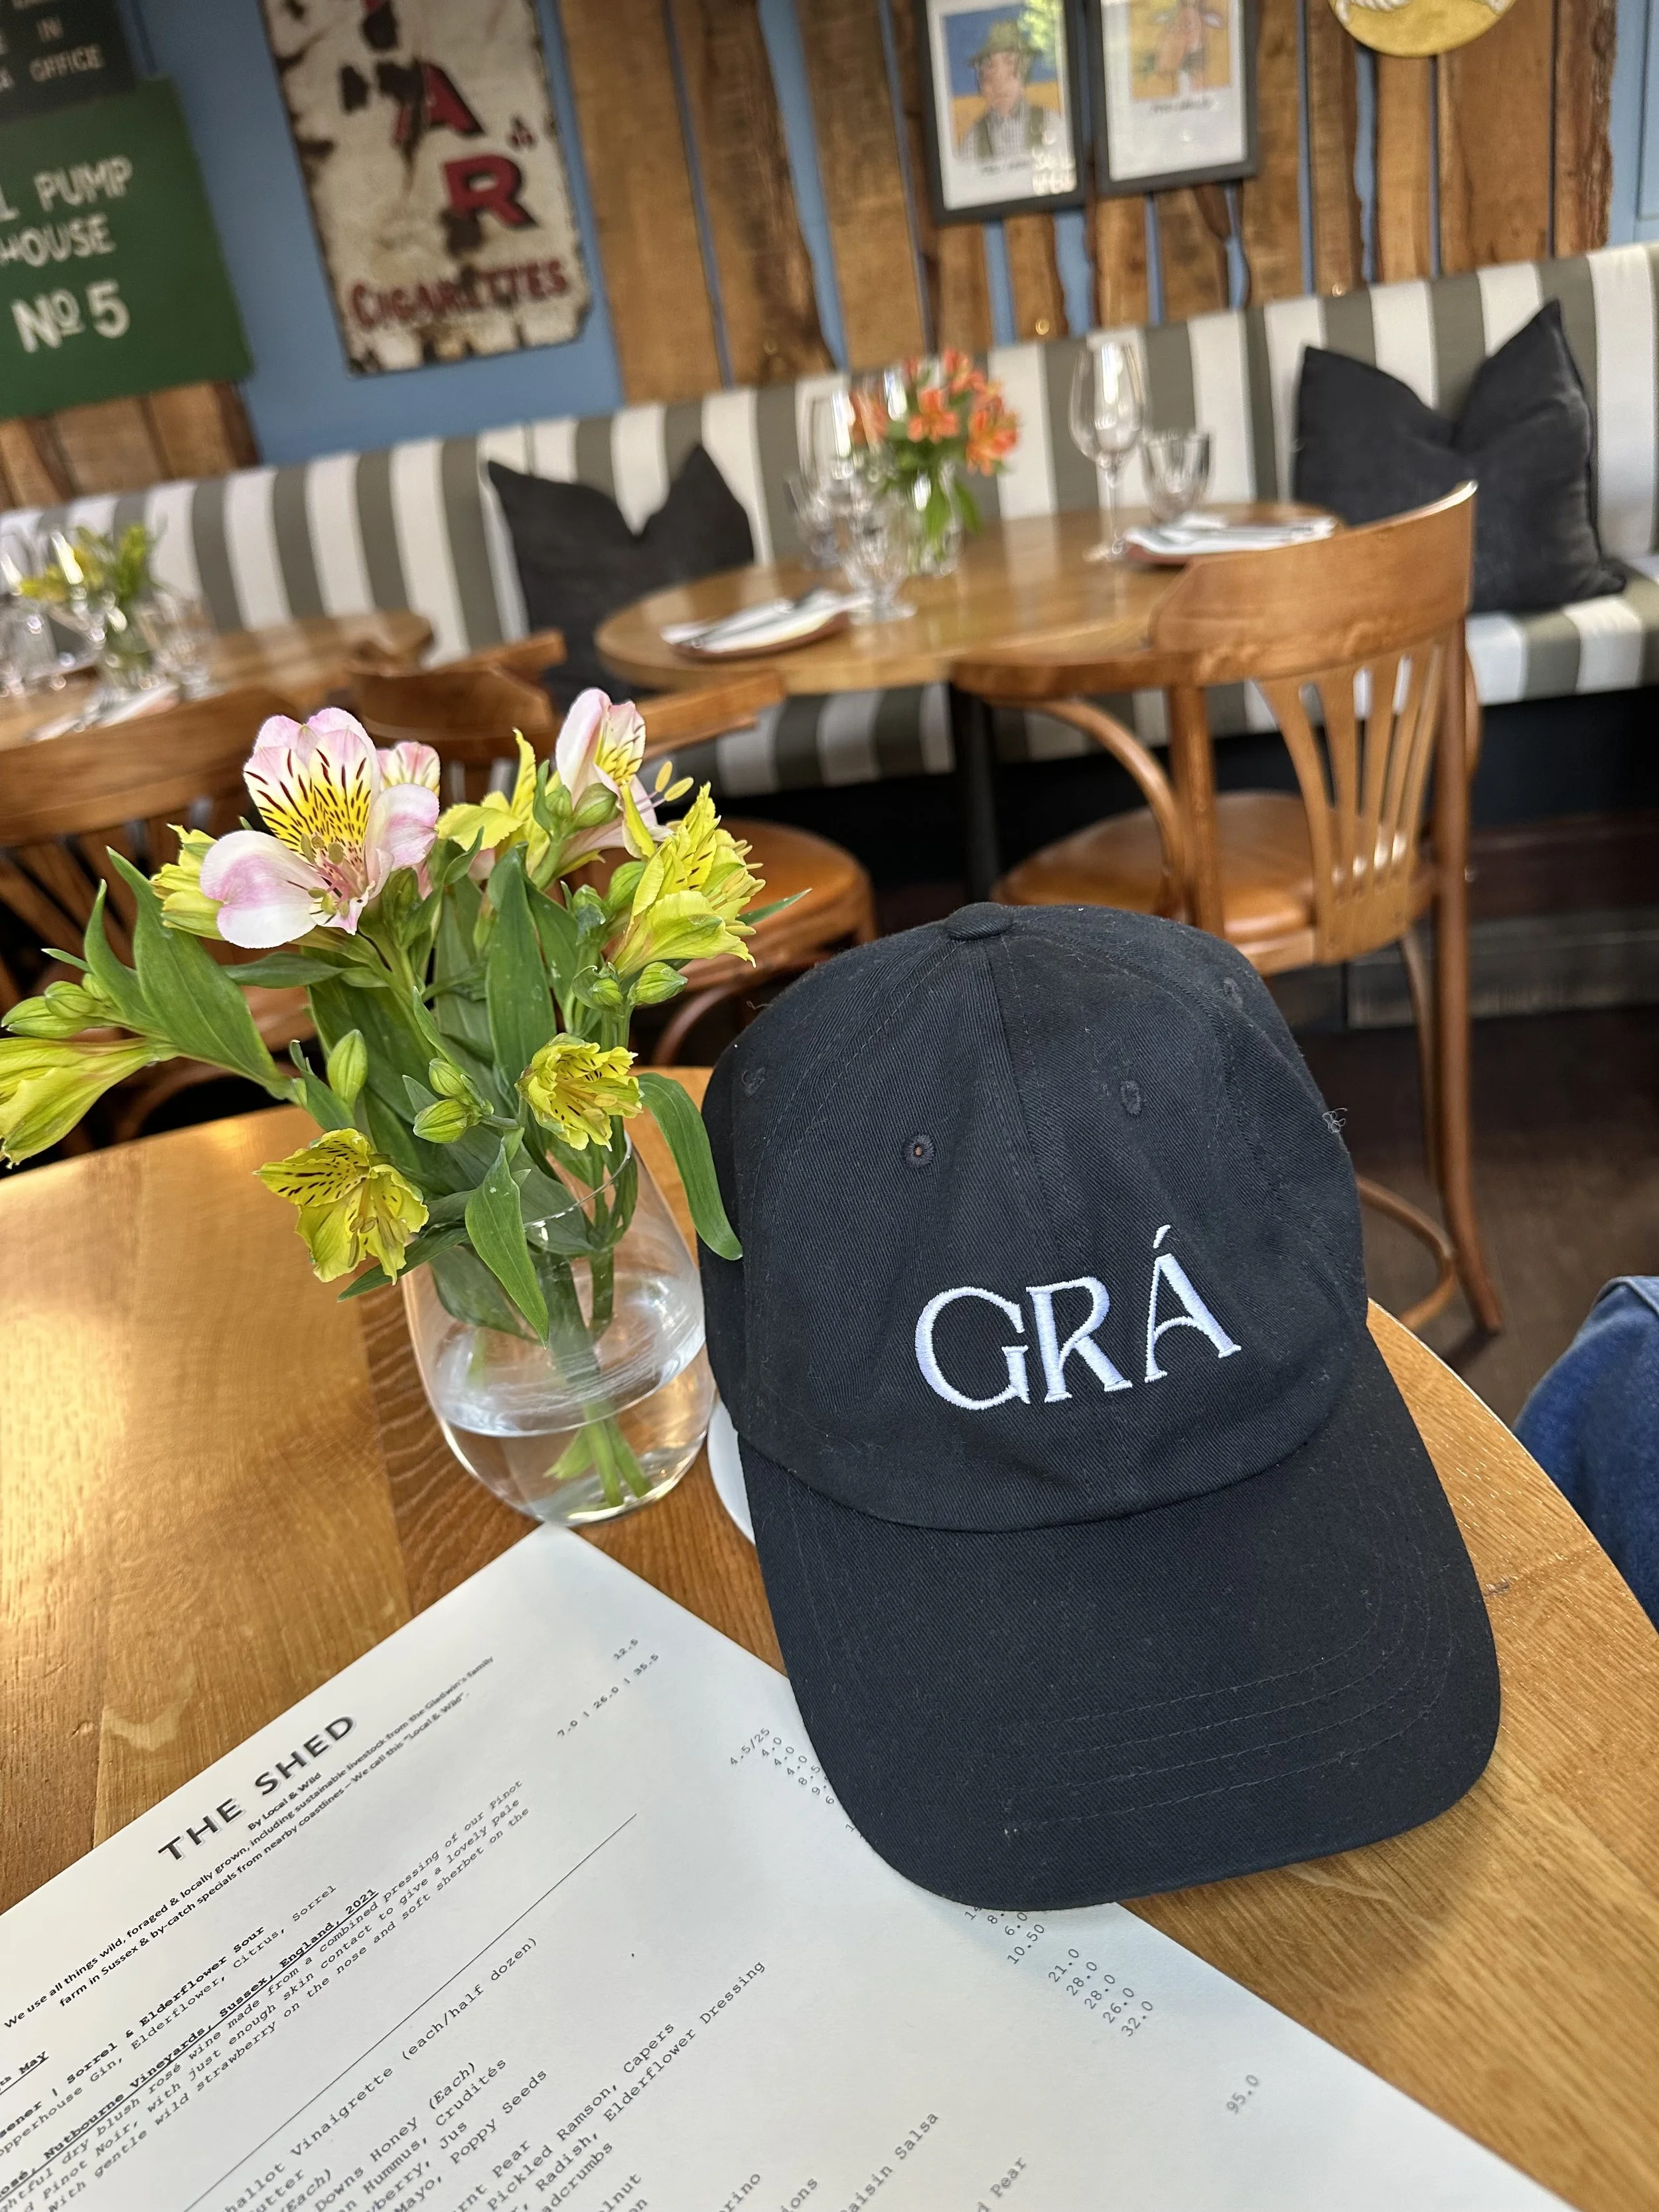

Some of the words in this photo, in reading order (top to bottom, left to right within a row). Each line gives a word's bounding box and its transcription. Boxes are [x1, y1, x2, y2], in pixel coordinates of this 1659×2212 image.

[33, 155, 133, 212] PUMP
[86, 278, 131, 338] 5
[915, 1224, 1242, 1410] GRÁ
[613, 1639, 638, 1660] 12.5
[557, 1720, 578, 1738] 7.0
[593, 1686, 619, 1709] 26.0
[634, 1653, 659, 1676] 35.5
[730, 1728, 770, 1765] 4.5/25
[761, 1737, 782, 1757] 4.0
[774, 1746, 794, 1767] 4.0
[786, 1755, 807, 1776] 4.0
[798, 1764, 821, 1786] 8.5
[159, 1797, 244, 1861] THE
[255, 1716, 355, 1796] SHED
[248, 1818, 261, 1830] By
[262, 1798, 288, 1820] Local
[298, 1772, 321, 1791] Wild
[4, 2013, 25, 2028] We
[27, 1996, 47, 2012] use
[50, 1982, 62, 1996] all
[64, 1958, 98, 1984] things
[100, 1938, 125, 1957] wild,
[127, 1904, 168, 1937] foraged
[180, 1872, 212, 1898] locally
[215, 1848, 250, 1874] grown,
[251, 1811, 295, 1846] including
[295, 1770, 346, 1812] sustainable
[346, 1739, 385, 1770] livestock
[386, 1722, 409, 1739] from
[409, 1710, 425, 1722] the
[60, 1985, 87, 2006] farm
[88, 1975, 100, 1984] in
[102, 1946, 138, 1975] Sussex
[150, 1904, 195, 1938] by-catch
[197, 1872, 236, 1904] specials
[237, 1854, 263, 1873] from
[264, 1826, 297, 1854] nearby
[299, 1789, 344, 1826] coastlines
[351, 1769, 369, 1782] We
[370, 1755, 386, 1769] call
[387, 1743, 403, 1755] this
[1005, 1913, 1027, 1935] 6.0
[1007, 1924, 1045, 1964] 10.50
[62, 2140, 88, 2164] dry
[97, 2099, 140, 2136] blush
[149, 2063, 180, 2093] rosé
[188, 2032, 220, 2060] wine
[228, 2000, 259, 2028] made
[268, 1968, 299, 1996] from
[320, 1901, 378, 1952] combined
[383, 1851, 439, 1903] pressing
[445, 1832, 458, 1847] of
[465, 1812, 483, 1830] our
[490, 1781, 522, 1810] Pinot
[90, 2058, 121, 2081] Gin,
[131, 1976, 224, 2049] Elderflower,
[234, 1929, 284, 1968] Citrus,
[293, 1885, 336, 1921] Sorrel
[95, 2130, 147, 2178] gentle
[155, 2093, 188, 2125] wild
[197, 2022, 275, 2091] strawberry
[284, 2003, 300, 2017] on
[307, 1978, 329, 1997] the
[336, 1947, 366, 1974] nose
[374, 1921, 396, 1943] and
[402, 1894, 430, 1919] soft
[437, 1847, 483, 1891] sherbet
[490, 1831, 503, 1843] on
[509, 1809, 528, 1826] the
[1048, 1949, 1080, 1983] 21.0
[1066, 1961, 1098, 1996] 28.0
[1084, 1974, 1116, 2009] 28.0
[43, 2161, 87, 2199] Pinot
[96, 2121, 137, 2157] Noir,
[147, 2083, 180, 2112] with
[189, 2049, 221, 2081] just
[229, 2005, 276, 2044] enough
[284, 1973, 313, 2000] skin
[321, 1925, 372, 1968] contact
[379, 1907, 393, 1920] to
[399, 1879, 428, 1905] give
[447, 1827, 486, 1864] lovely
[492, 1800, 519, 1826] pale
[67, 2043, 117, 2084] Sorrel
[126, 2029, 134, 2038] &
[139, 1956, 227, 2027] Elderflower
[234, 1927, 264, 1953] Sour
[1103, 1988, 1135, 2023] 26.0
[1121, 2000, 1153, 2036] 32.0
[0, 2075, 12, 2091] th
[20, 2051, 49, 2076] May
[1, 2168, 38, 2197] osé,
[44, 2095, 127, 2160] Nutbourne
[129, 2025, 218, 2093] Vineyards,
[220, 1975, 276, 2020] Sussex,
[279, 1921, 345, 1971] England,
[346, 1889, 379, 1918] 2021
[291, 2069, 392, 2155] Vinaigrette
[403, 1984, 483, 2060] (each/half
[491, 1938, 536, 1980] dozen)
[536, 2133, 597, 2191] Radish,
[603, 2029, 695, 2122] Elderflower
[699, 1962, 764, 2024] Dressing
[1226, 2075, 1260, 2113] 95.0
[315, 2168, 363, 2212] Downs
[370, 2116, 417, 2162] Honey
[429, 2063, 474, 2109] (Each)
[363, 2138, 427, 2194] Hummus,
[436, 2060, 506, 2126] Crudités
[440, 2122, 467, 2149] Jus
[450, 2118, 496, 2164] Poppy
[503, 2071, 546, 2114] Seeds
[487, 2145, 553, 2211] Pickled
[557, 2085, 616, 2141] Ramson,
[624, 2024, 674, 2073] Capers
[256, 2170, 303, 2212] utter
[453, 2185, 486, 2212] rnt
[492, 2140, 530, 2178] Pear
[841, 2166, 893, 2212] aisin
[895, 2114, 938, 2160] Salsa
[991, 2158, 1025, 2197] Pear
[599, 2174, 641, 2212] lnut
[719, 2174, 760, 2212] rino
